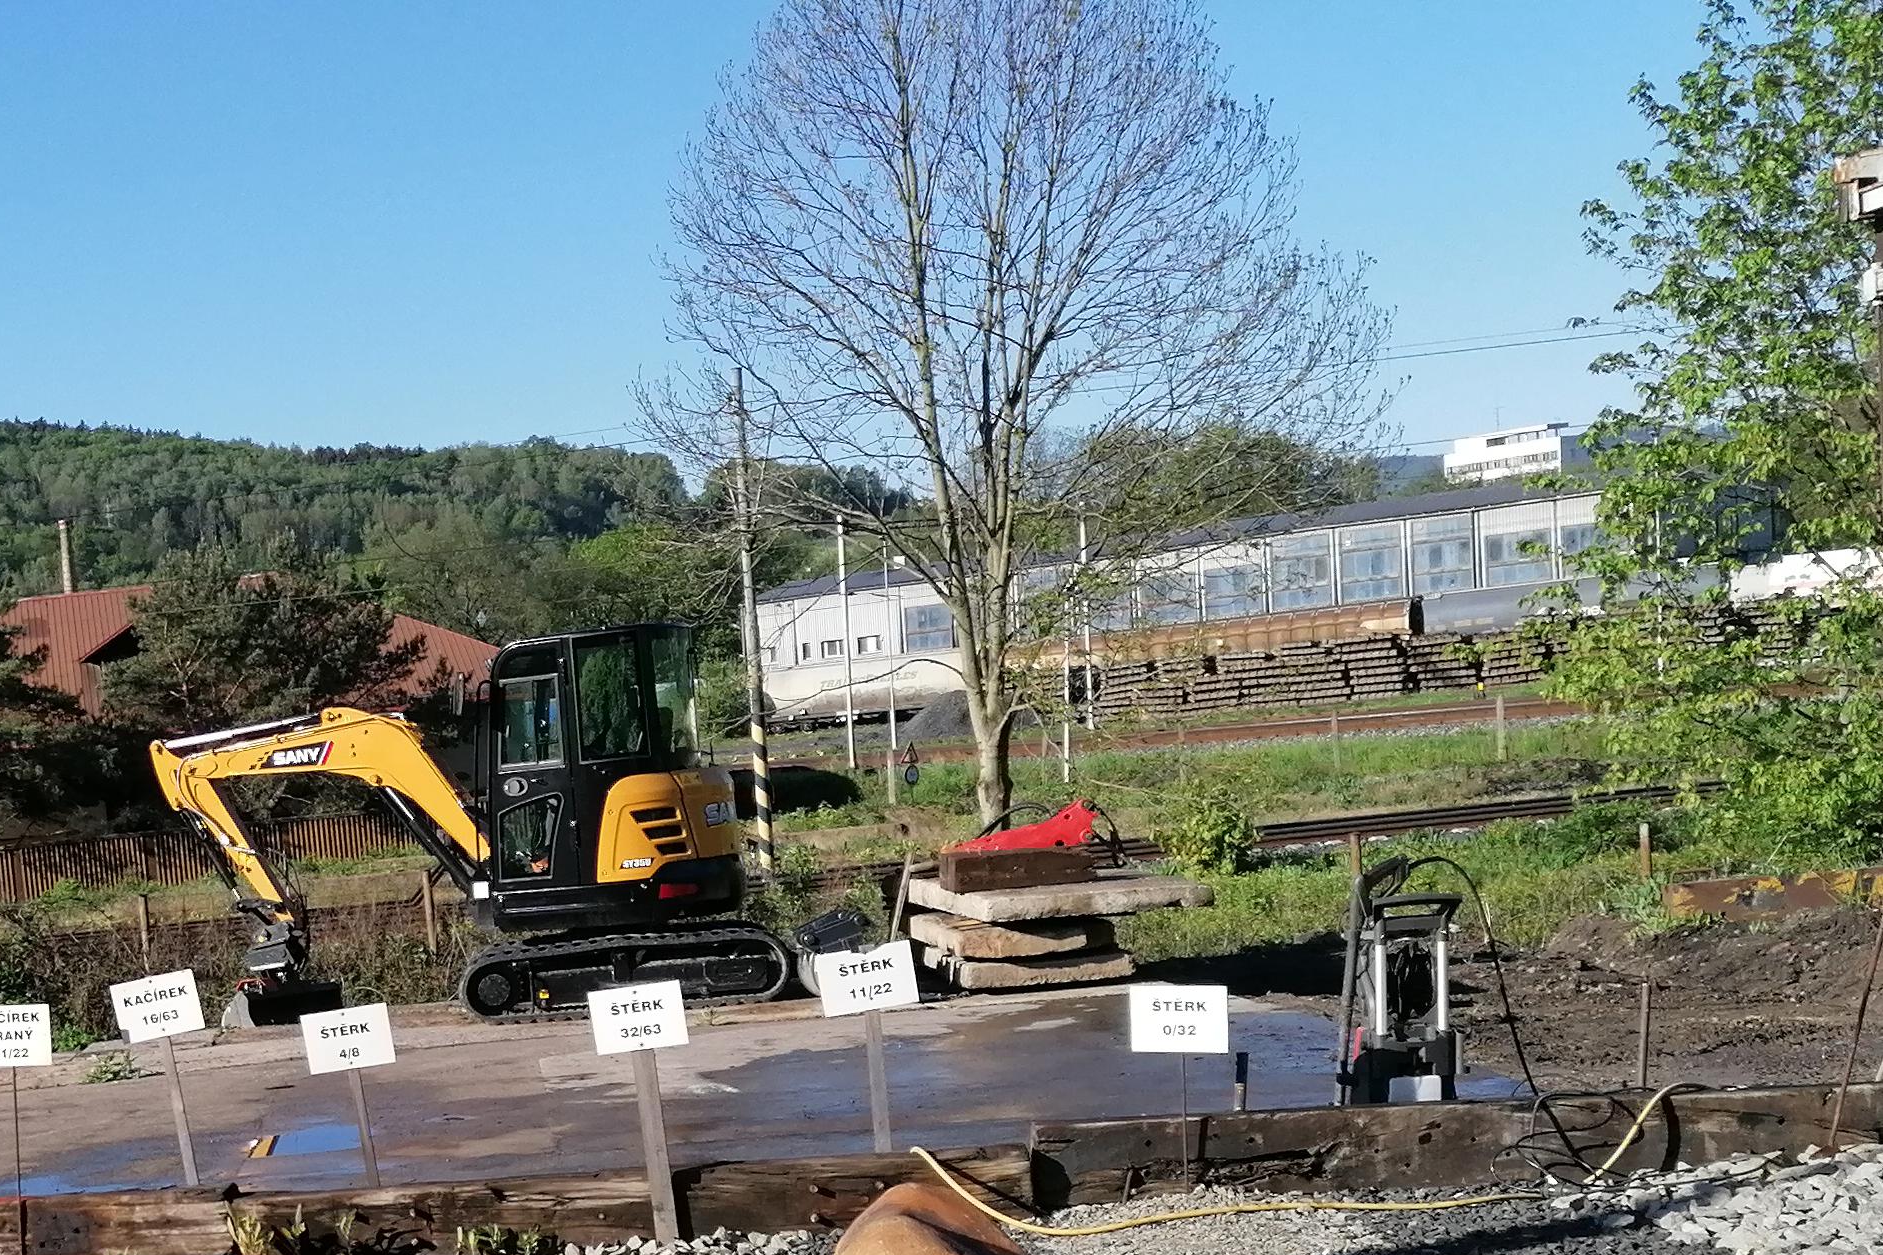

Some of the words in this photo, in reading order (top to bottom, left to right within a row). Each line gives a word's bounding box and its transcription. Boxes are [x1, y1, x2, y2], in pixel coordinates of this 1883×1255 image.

[273, 747, 321, 765] SANY
[838, 958, 894, 976] ŠTĚRK
[123, 985, 188, 1007] KAČÍREK
[849, 983, 893, 999] 11/22
[610, 999, 664, 1015] ŠTĚRK
[1152, 997, 1207, 1012] ŠTĚRK
[142, 1009, 179, 1025] 16/63
[320, 1022, 371, 1039] ŠTĚRK
[620, 1024, 661, 1038] 32/63
[1163, 1025, 1196, 1036] 0/32
[339, 1047, 360, 1059] 4/8
